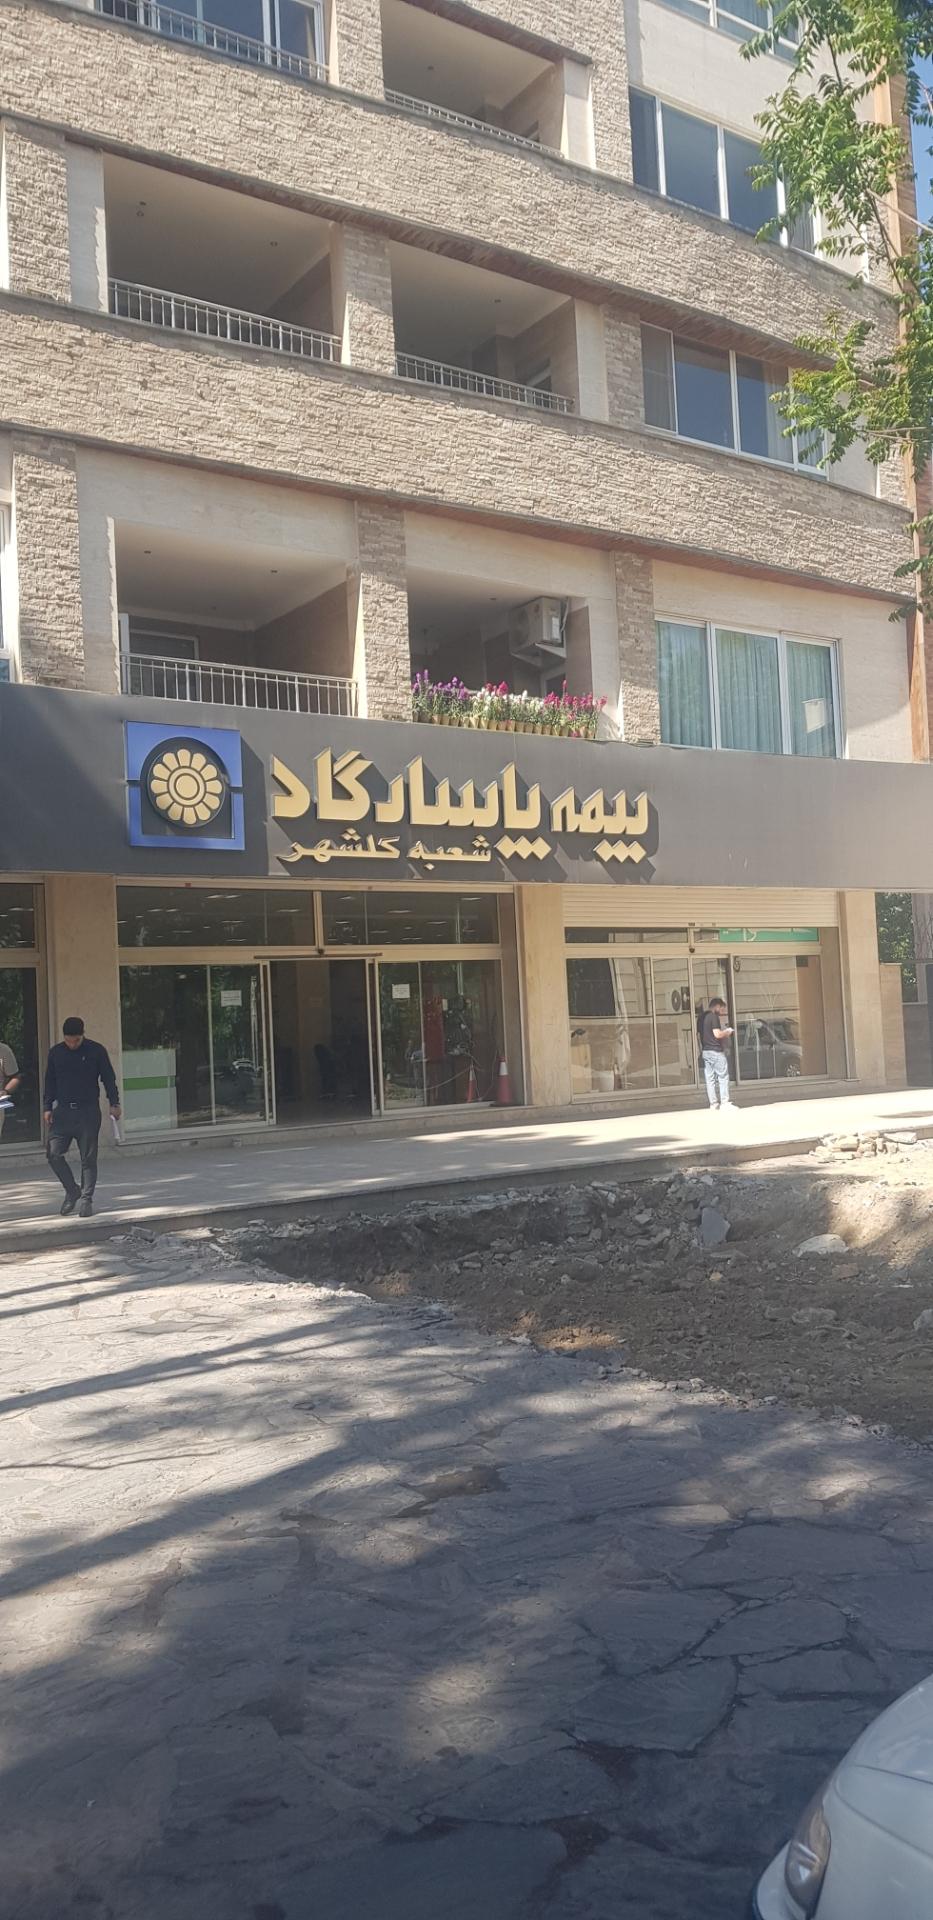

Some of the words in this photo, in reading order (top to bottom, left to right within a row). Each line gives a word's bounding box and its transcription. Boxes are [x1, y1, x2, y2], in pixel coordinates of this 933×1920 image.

[270, 746, 552, 861] پاسارگاد
[550, 786, 648, 863] بیمه
[406, 834, 492, 871] شعبه
